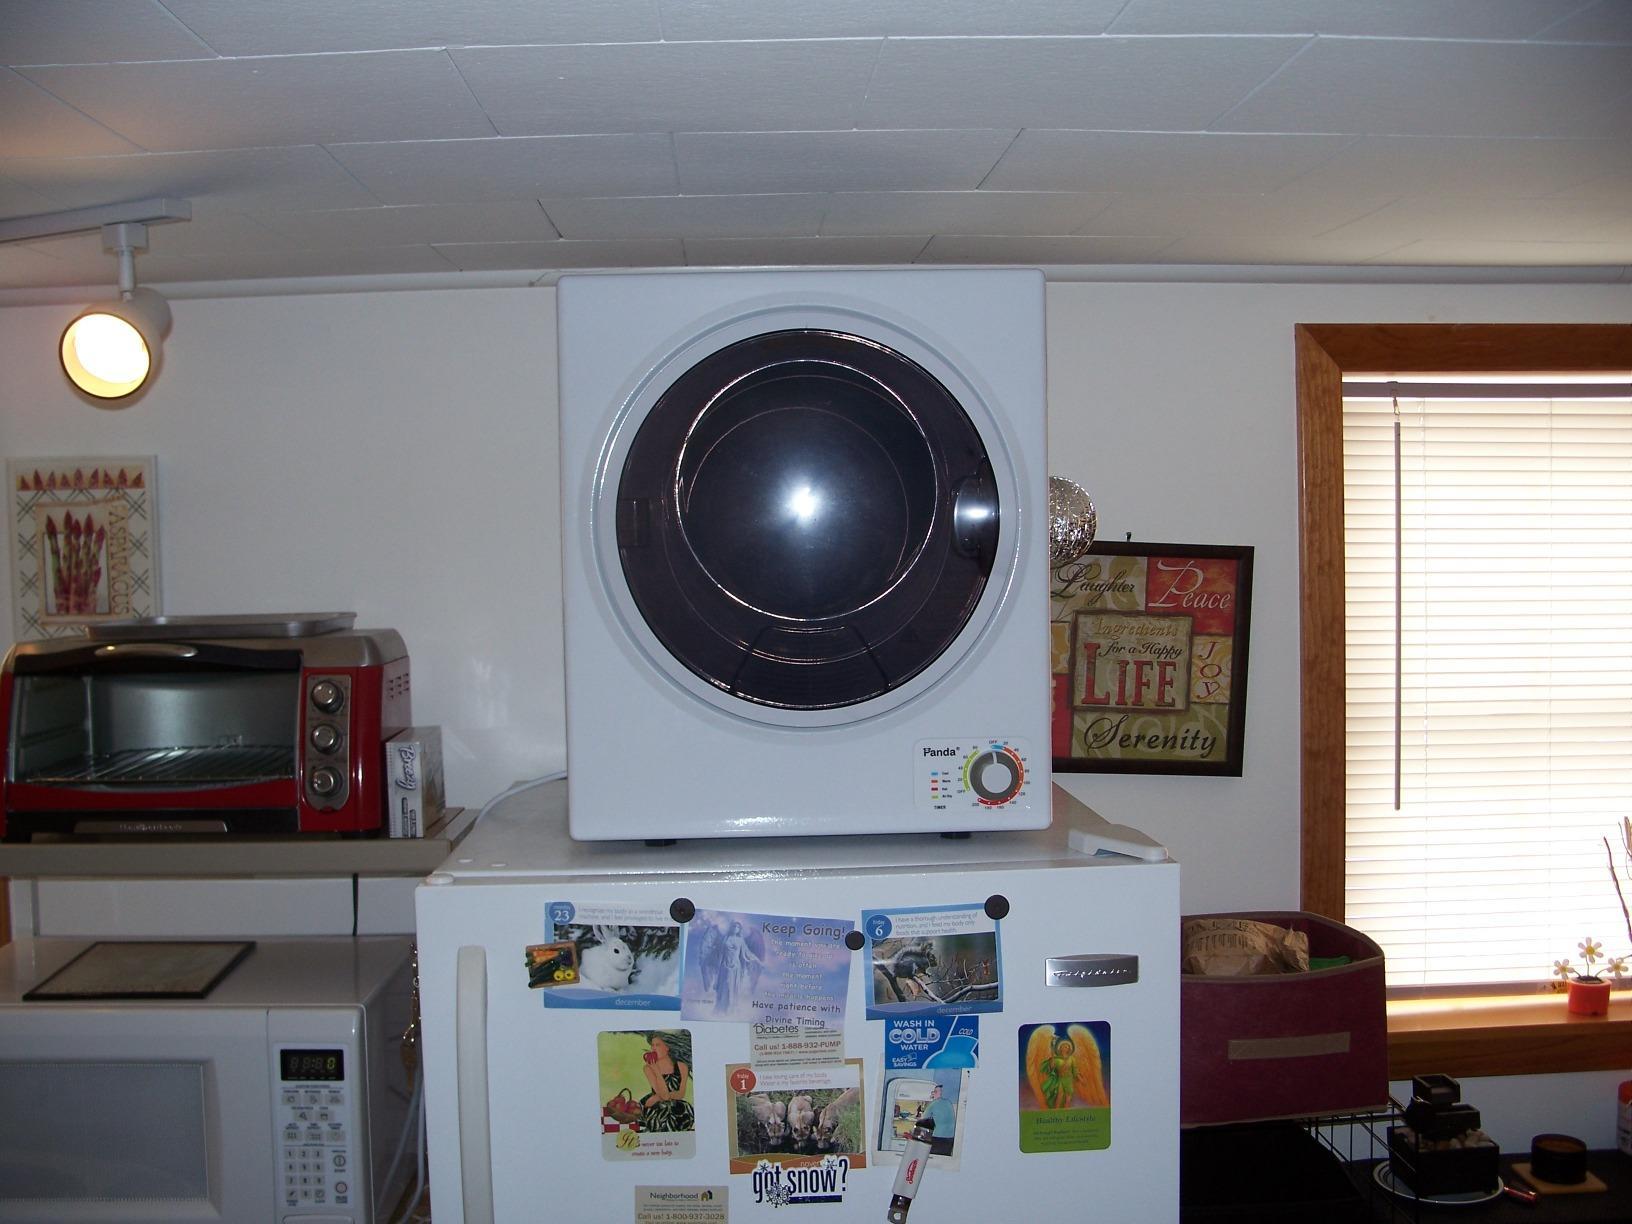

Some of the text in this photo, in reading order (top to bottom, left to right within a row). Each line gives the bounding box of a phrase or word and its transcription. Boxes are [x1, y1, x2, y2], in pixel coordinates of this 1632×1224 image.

[1051, 563, 1135, 606] Laughter
[1148, 560, 1231, 609] Peace
[1099, 641, 1125, 657] for
[1139, 642, 1182, 659] Happy
[1082, 642, 1176, 707] LIFE
[1084, 714, 1216, 758] Serenity
[923, 747, 957, 757] Panda
[554, 910, 569, 921] 23
[762, 922, 845, 940] Keep Going!
[875, 926, 883, 936] 6
[615, 999, 650, 1007] december
[752, 1000, 841, 1013] Have patience with
[937, 1004, 972, 1014] december
[765, 1015, 826, 1028] Divine Timing
[893, 1020, 922, 1028] WASH
[755, 1024, 799, 1034] Diabetes
[889, 1028, 940, 1044] COLD
[754, 1043, 768, 1051] Call
[740, 1079, 747, 1090] 1
[753, 1158, 848, 1204] got snow?
[650, 1192, 699, 1201] Neighborhood
